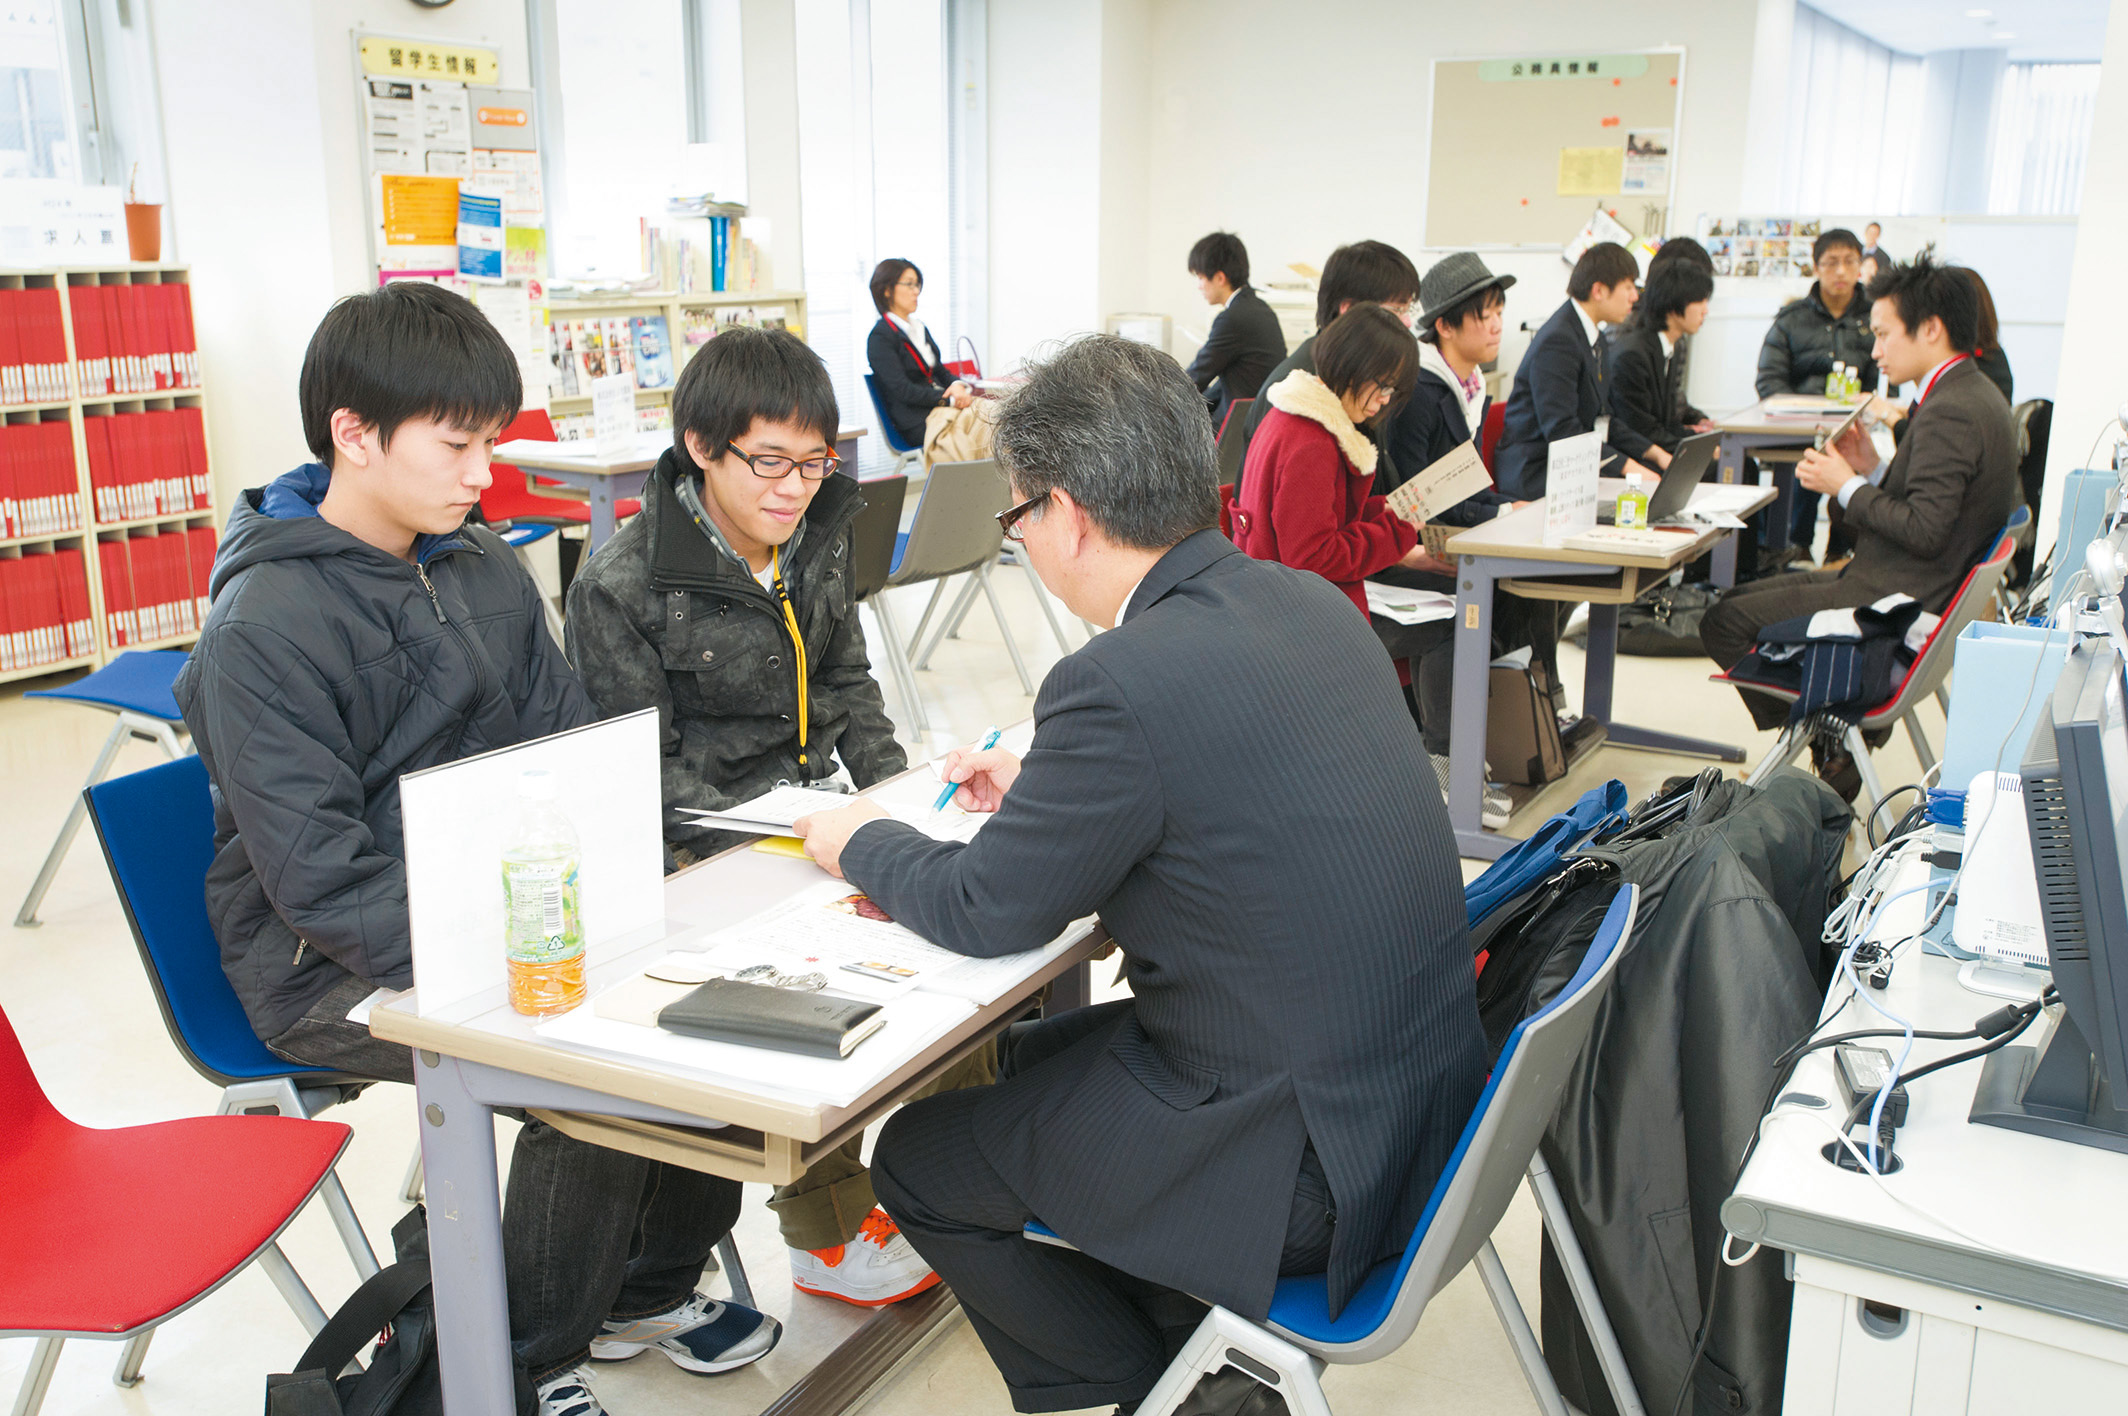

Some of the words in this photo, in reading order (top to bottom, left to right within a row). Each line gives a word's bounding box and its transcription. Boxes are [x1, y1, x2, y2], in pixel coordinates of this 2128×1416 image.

[389, 47, 477, 76] 留学生情報
[1511, 61, 1599, 76] 公務員情報
